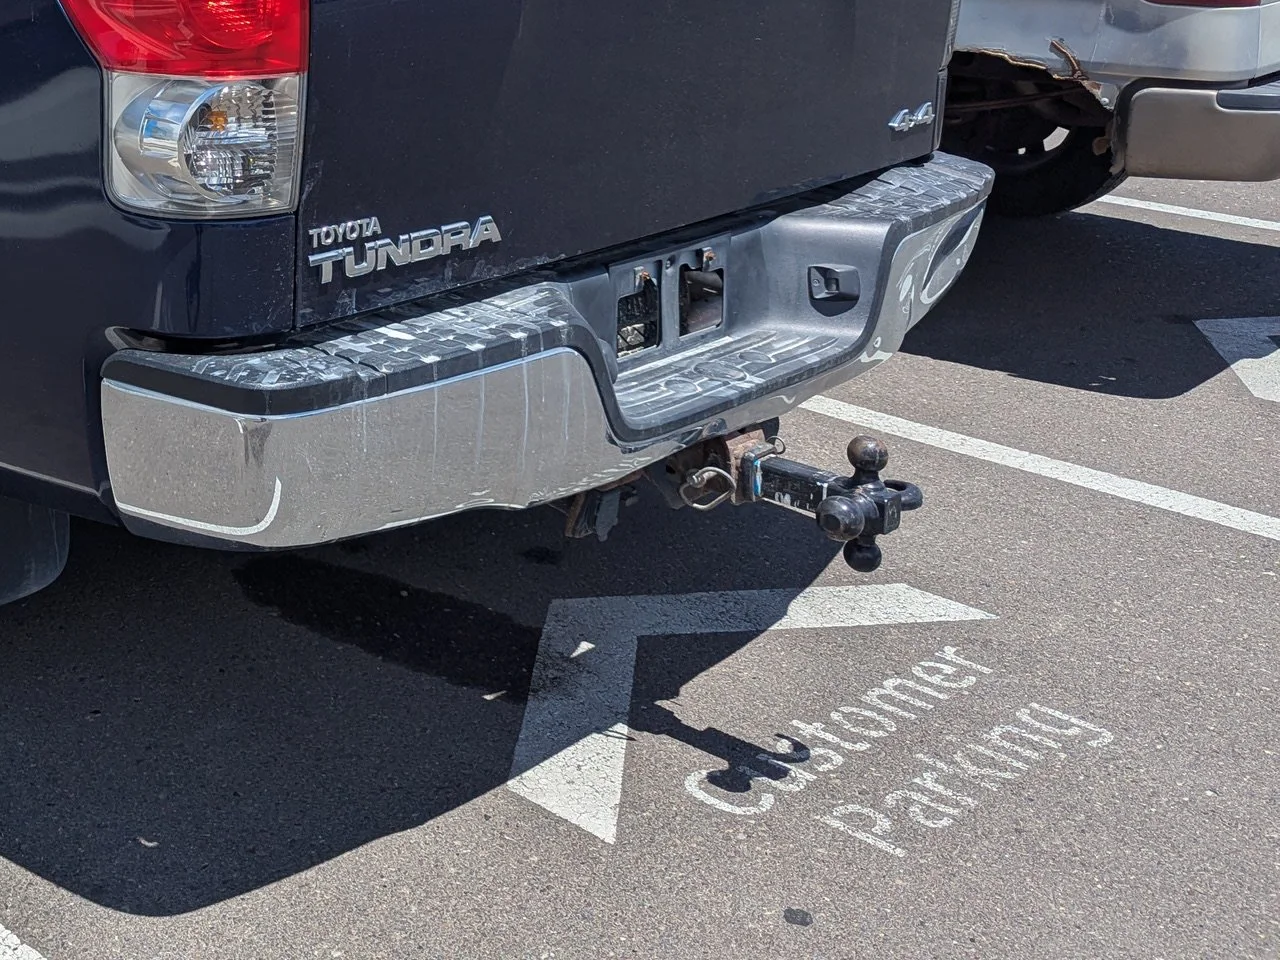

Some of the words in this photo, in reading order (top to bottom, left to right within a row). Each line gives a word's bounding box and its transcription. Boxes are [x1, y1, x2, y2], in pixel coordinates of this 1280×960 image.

[308, 216, 382, 248] TOYOTA
[308, 215, 502, 284] TUNDRA
[684, 645, 994, 815] Customer
[817, 702, 1114, 857] Parking
